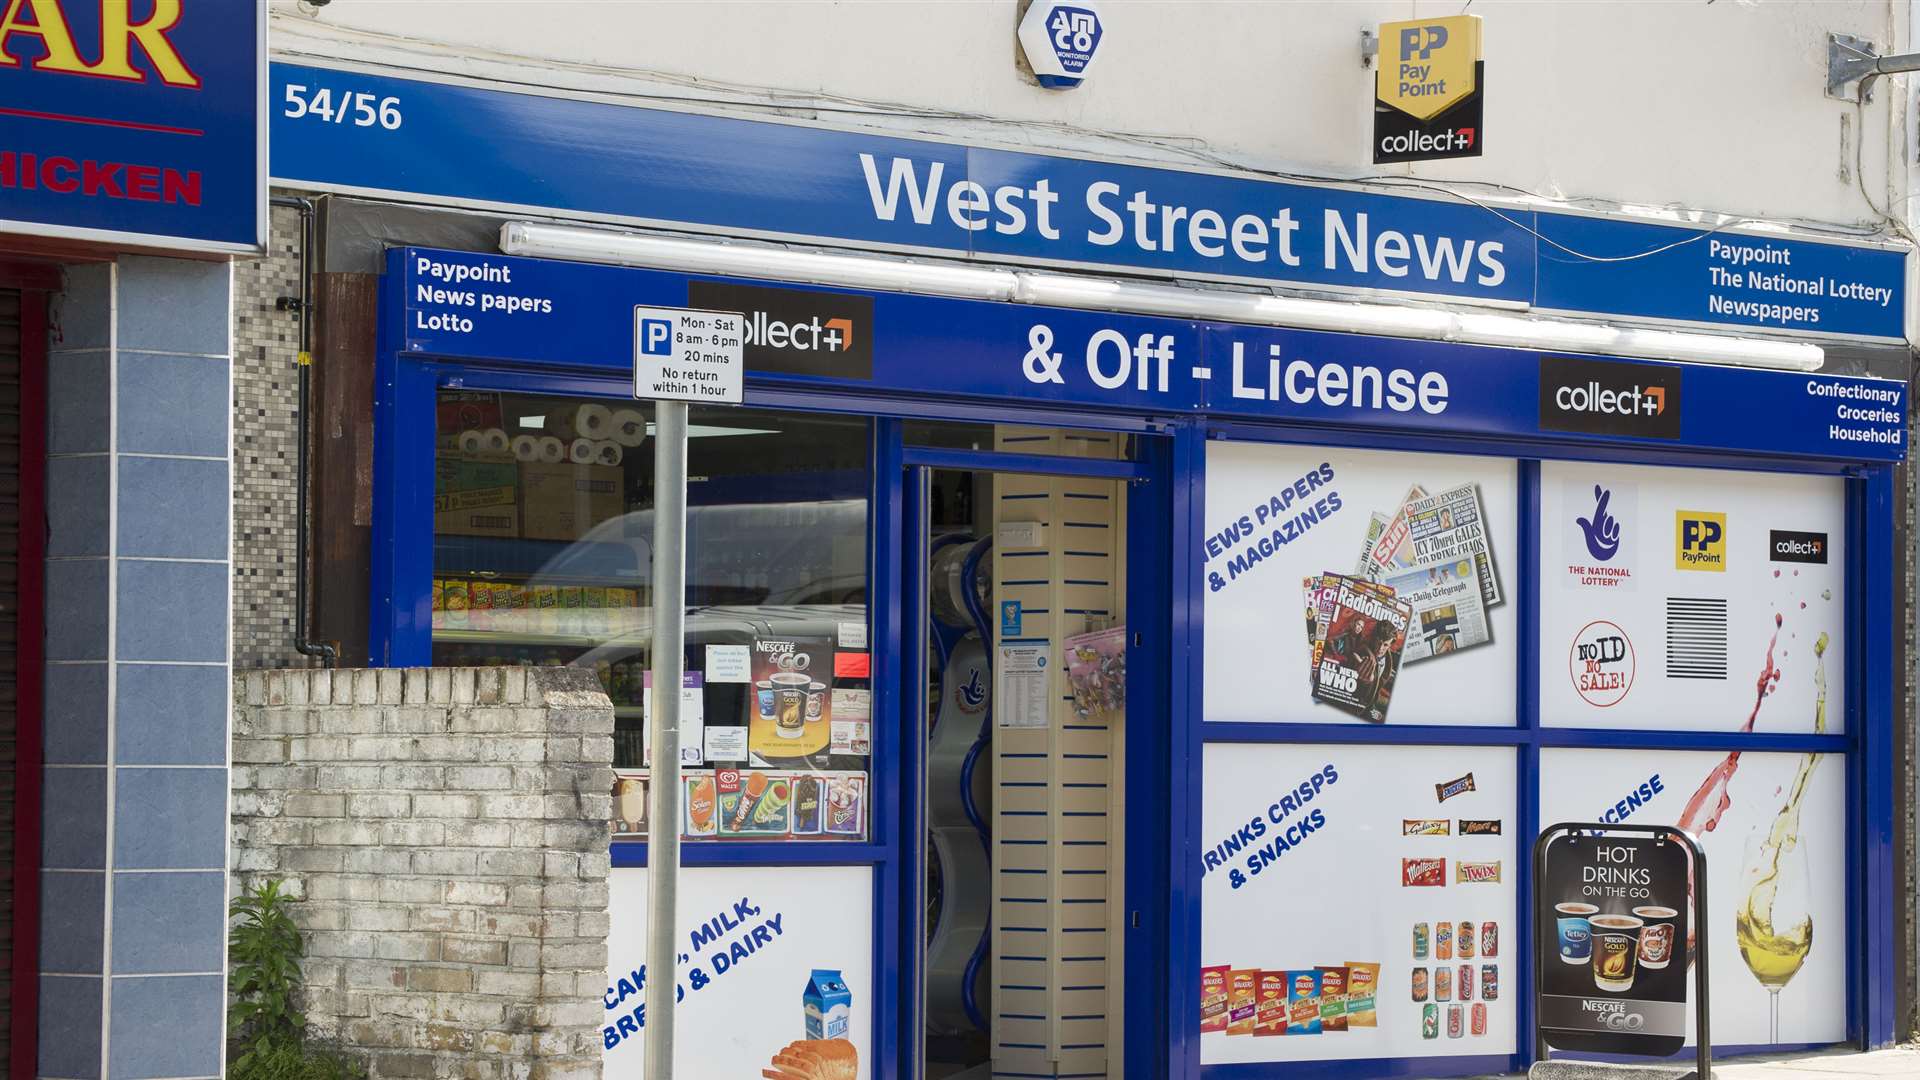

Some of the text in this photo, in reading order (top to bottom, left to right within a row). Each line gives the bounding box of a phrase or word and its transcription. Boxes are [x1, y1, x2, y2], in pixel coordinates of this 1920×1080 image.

[1400, 26, 1448, 61] PP
[1057, 51, 1090, 61] MONITORED
[1063, 60, 1084, 68] ALARM
[1400, 63, 1430, 82] Pay
[1399, 79, 1446, 97] Point
[284, 84, 402, 130] 54/56
[1381, 128, 1468, 153] collect+
[859, 153, 1507, 287] West Street News
[1709, 240, 1790, 266] Paypoint
[417, 257, 511, 284] Paypoint
[1709, 267, 1893, 307] The National Lottery
[417, 284, 552, 314] News papers
[1709, 295, 1820, 324] Newspapers
[417, 311, 473, 333] Lotto
[680, 316, 705, 329] Mon
[714, 319, 735, 332] Sat
[649, 323, 668, 352] P
[676, 332, 683, 343] 8
[686, 335, 703, 345] am
[712, 335, 719, 346] 6
[722, 337, 739, 350] pm
[684, 350, 730, 365] 20 mins
[662, 367, 718, 382] No return
[1022, 324, 1065, 385] &
[1086, 329, 1174, 392] Off
[1232, 341, 1449, 415] License
[653, 381, 727, 397] within 1 hour
[1556, 382, 1658, 416] collect+
[1806, 380, 1901, 406] Confectionary
[1837, 404, 1901, 424] Groceries
[1829, 425, 1901, 445] Household
[1255, 462, 1335, 525] PAPERS
[1415, 497, 1436, 512] DAILY
[1440, 486, 1473, 504] EXPRESS
[1208, 571, 1227, 593] &
[1227, 491, 1343, 580] MAGAZINES
[1414, 539, 1431, 557] ICY
[1455, 522, 1482, 544] GALES
[1683, 520, 1721, 551] PP
[1682, 552, 1721, 564] PayPoint
[1568, 566, 1631, 577] THE NATIONAL
[1582, 577, 1619, 587] LOTTERY
[1413, 591, 1432, 603] Daily
[1432, 582, 1467, 598] Telegraph
[1578, 636, 1626, 663] NO ID
[1320, 661, 1359, 680] ALL NEW
[1586, 660, 1602, 674] NO
[1319, 670, 1358, 693] WHO
[1580, 671, 1626, 691] SALE!
[1268, 764, 1339, 825] CRISPS
[1229, 808, 1326, 889] & SNACKS
[1597, 846, 1638, 864] HOT
[1583, 866, 1651, 885] DRINKS
[1583, 885, 1650, 899] ON THE GO
[690, 897, 761, 952] MILK,
[1567, 930, 1587, 940] Tetley
[689, 967, 711, 991] &
[711, 912, 783, 976] DAIRY
[1604, 942, 1627, 950] GOLD
[1582, 1000, 1626, 1013] NESCAFÉ
[828, 1018, 848, 1036] MILK
